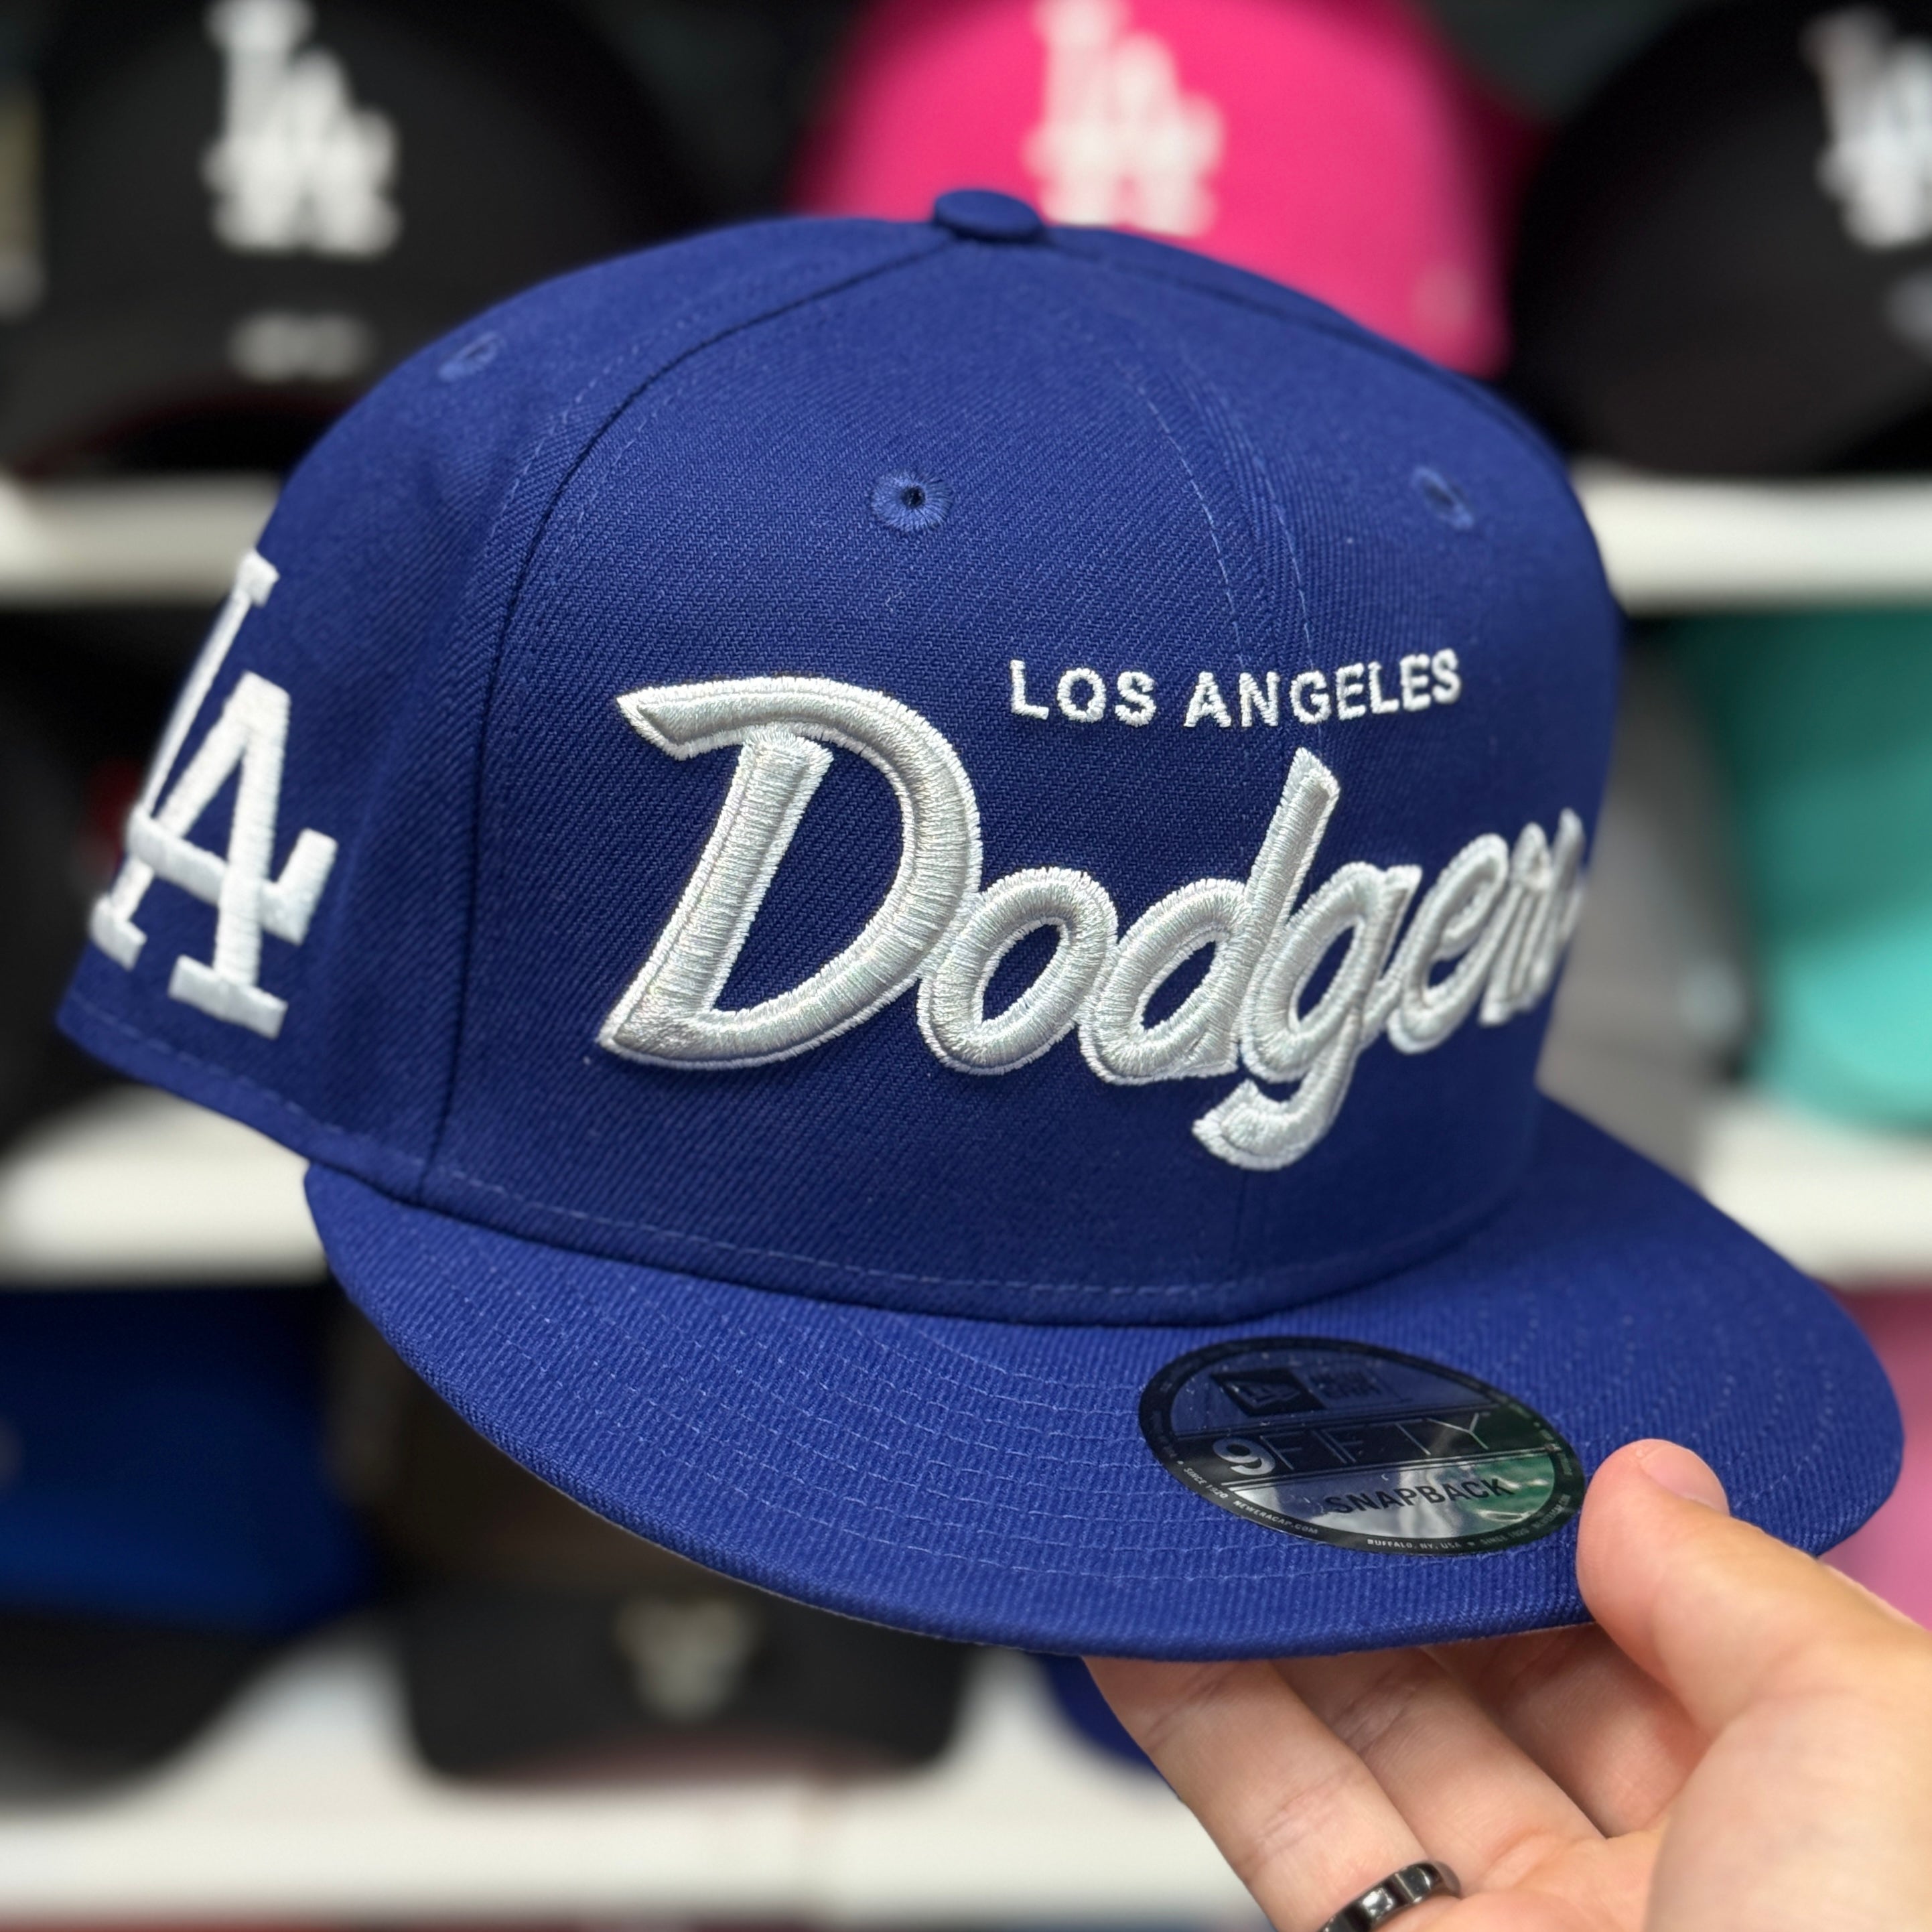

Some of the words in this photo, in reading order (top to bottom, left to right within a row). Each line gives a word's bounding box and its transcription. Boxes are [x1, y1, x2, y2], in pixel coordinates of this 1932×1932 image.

[1010, 659, 1157, 727] LOS
[1183, 648, 1462, 728] ANGELES
[88, 549, 338, 1040] LA
[1213, 1412, 1491, 1476] 9FIFTY
[1183, 1467, 1208, 1485] SINCE
[1206, 1484, 1229, 1499] 1920
[1233, 1500, 1318, 1535] NEWERACAP.COM
[1324, 1478, 1514, 1514] SNAPBACK
